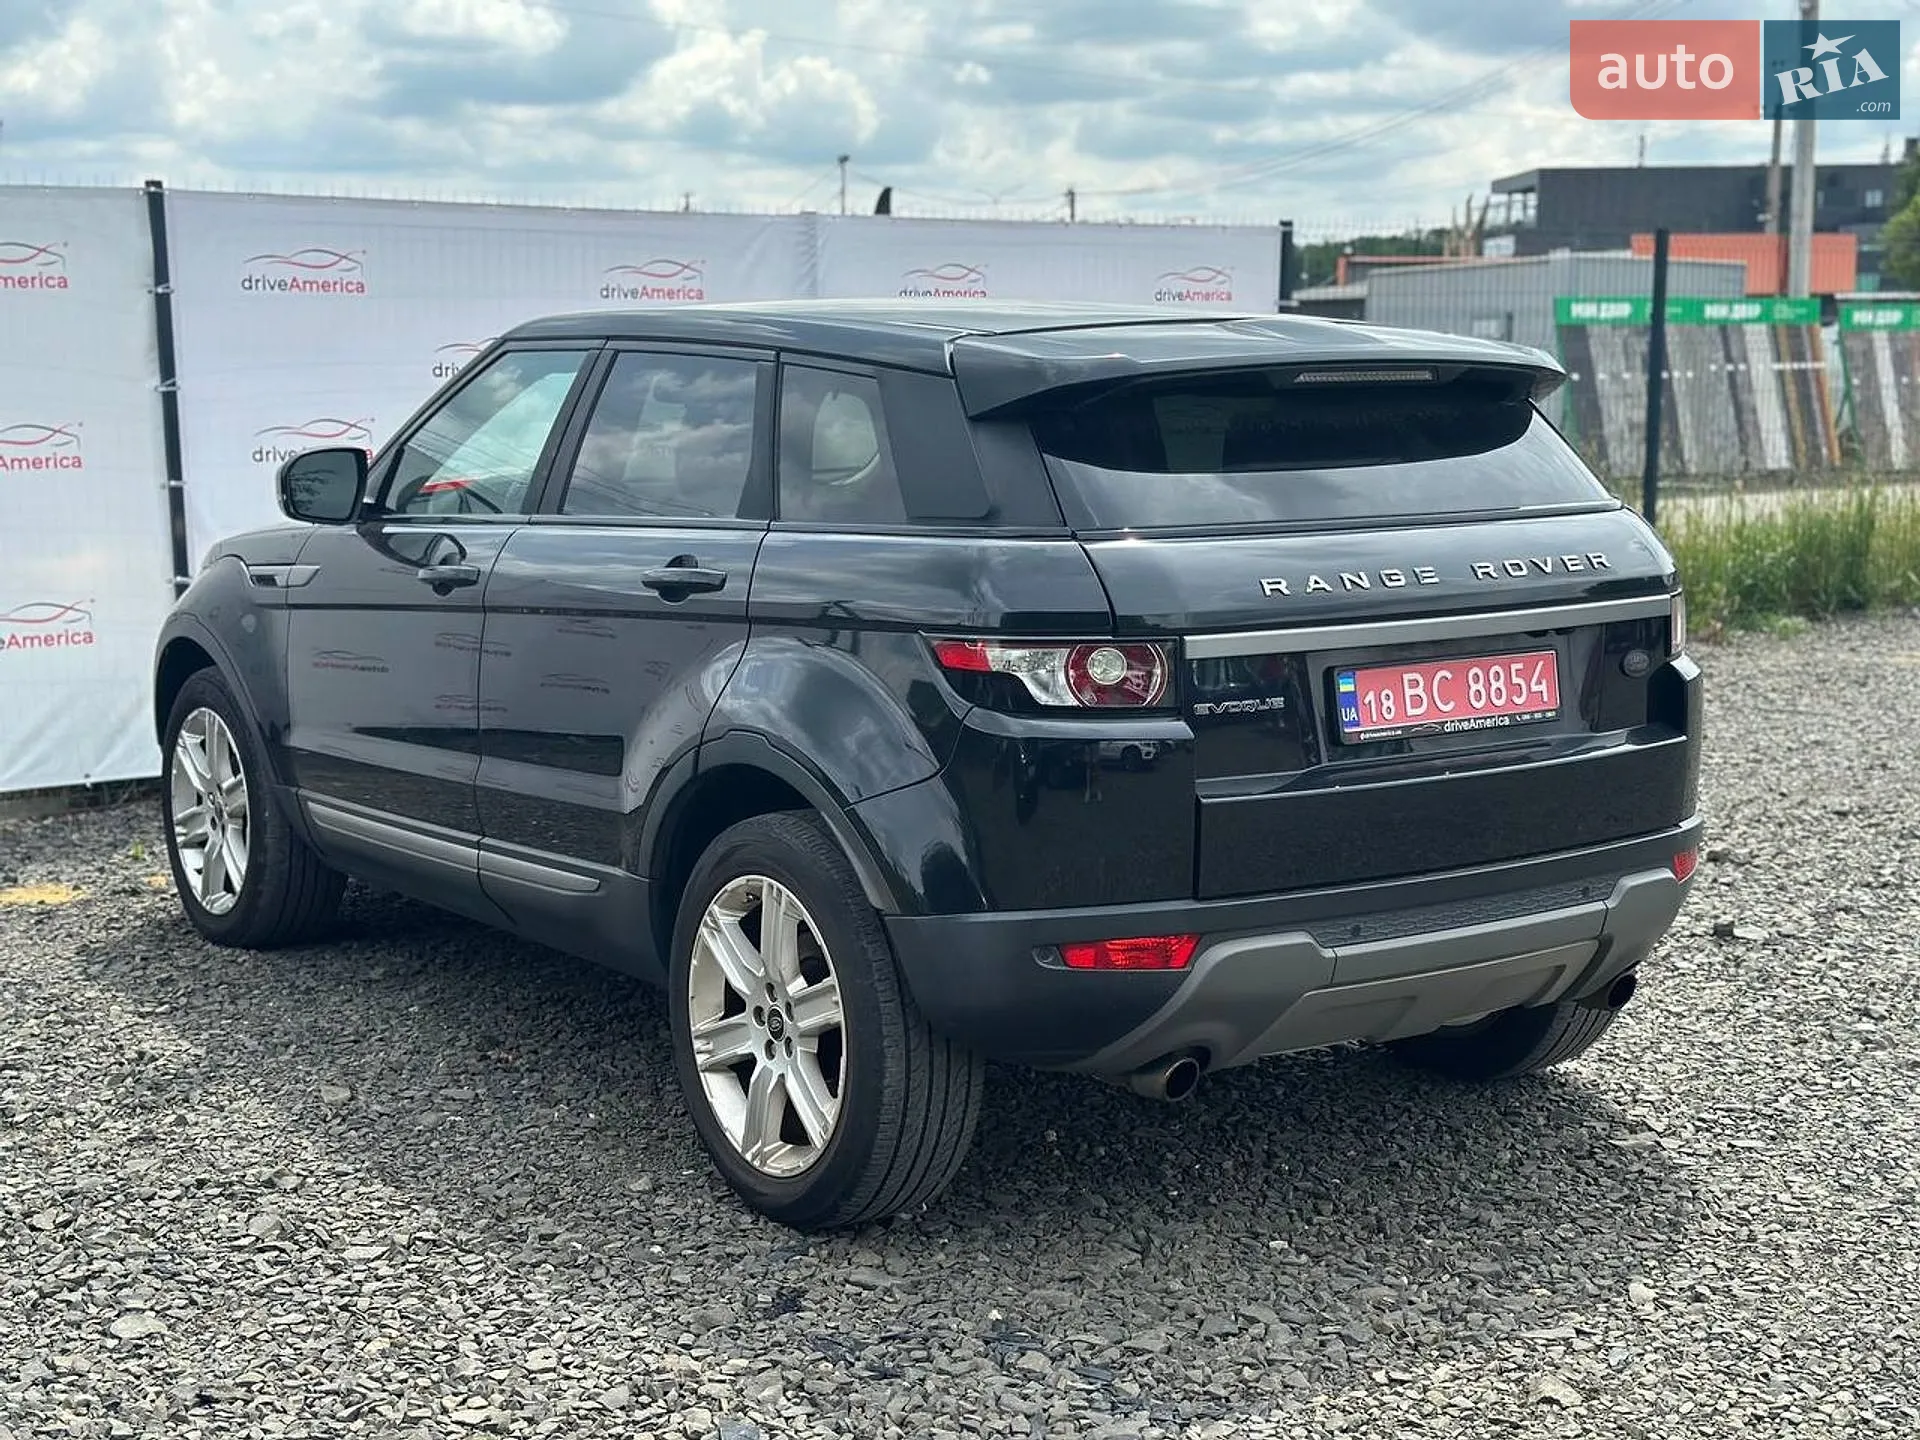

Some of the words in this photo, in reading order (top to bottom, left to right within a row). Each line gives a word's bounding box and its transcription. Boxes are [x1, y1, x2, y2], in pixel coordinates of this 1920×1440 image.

[0, 272, 68, 289] merica
[241, 274, 366, 294] driveAmerica
[600, 283, 704, 301] driveAmerica
[1154, 288, 1232, 302] driveAmerica
[1260, 565, 1440, 597] RANGE
[1470, 551, 1612, 581] ROVER
[0, 629, 94, 650] America
[1363, 688, 1396, 723] 18
[1402, 669, 1456, 717] BC
[1465, 660, 1549, 710] 8854
[1193, 697, 1285, 715] EVOQUE
[1341, 707, 1358, 722] UA
[1443, 714, 1511, 733] driveAmerica
